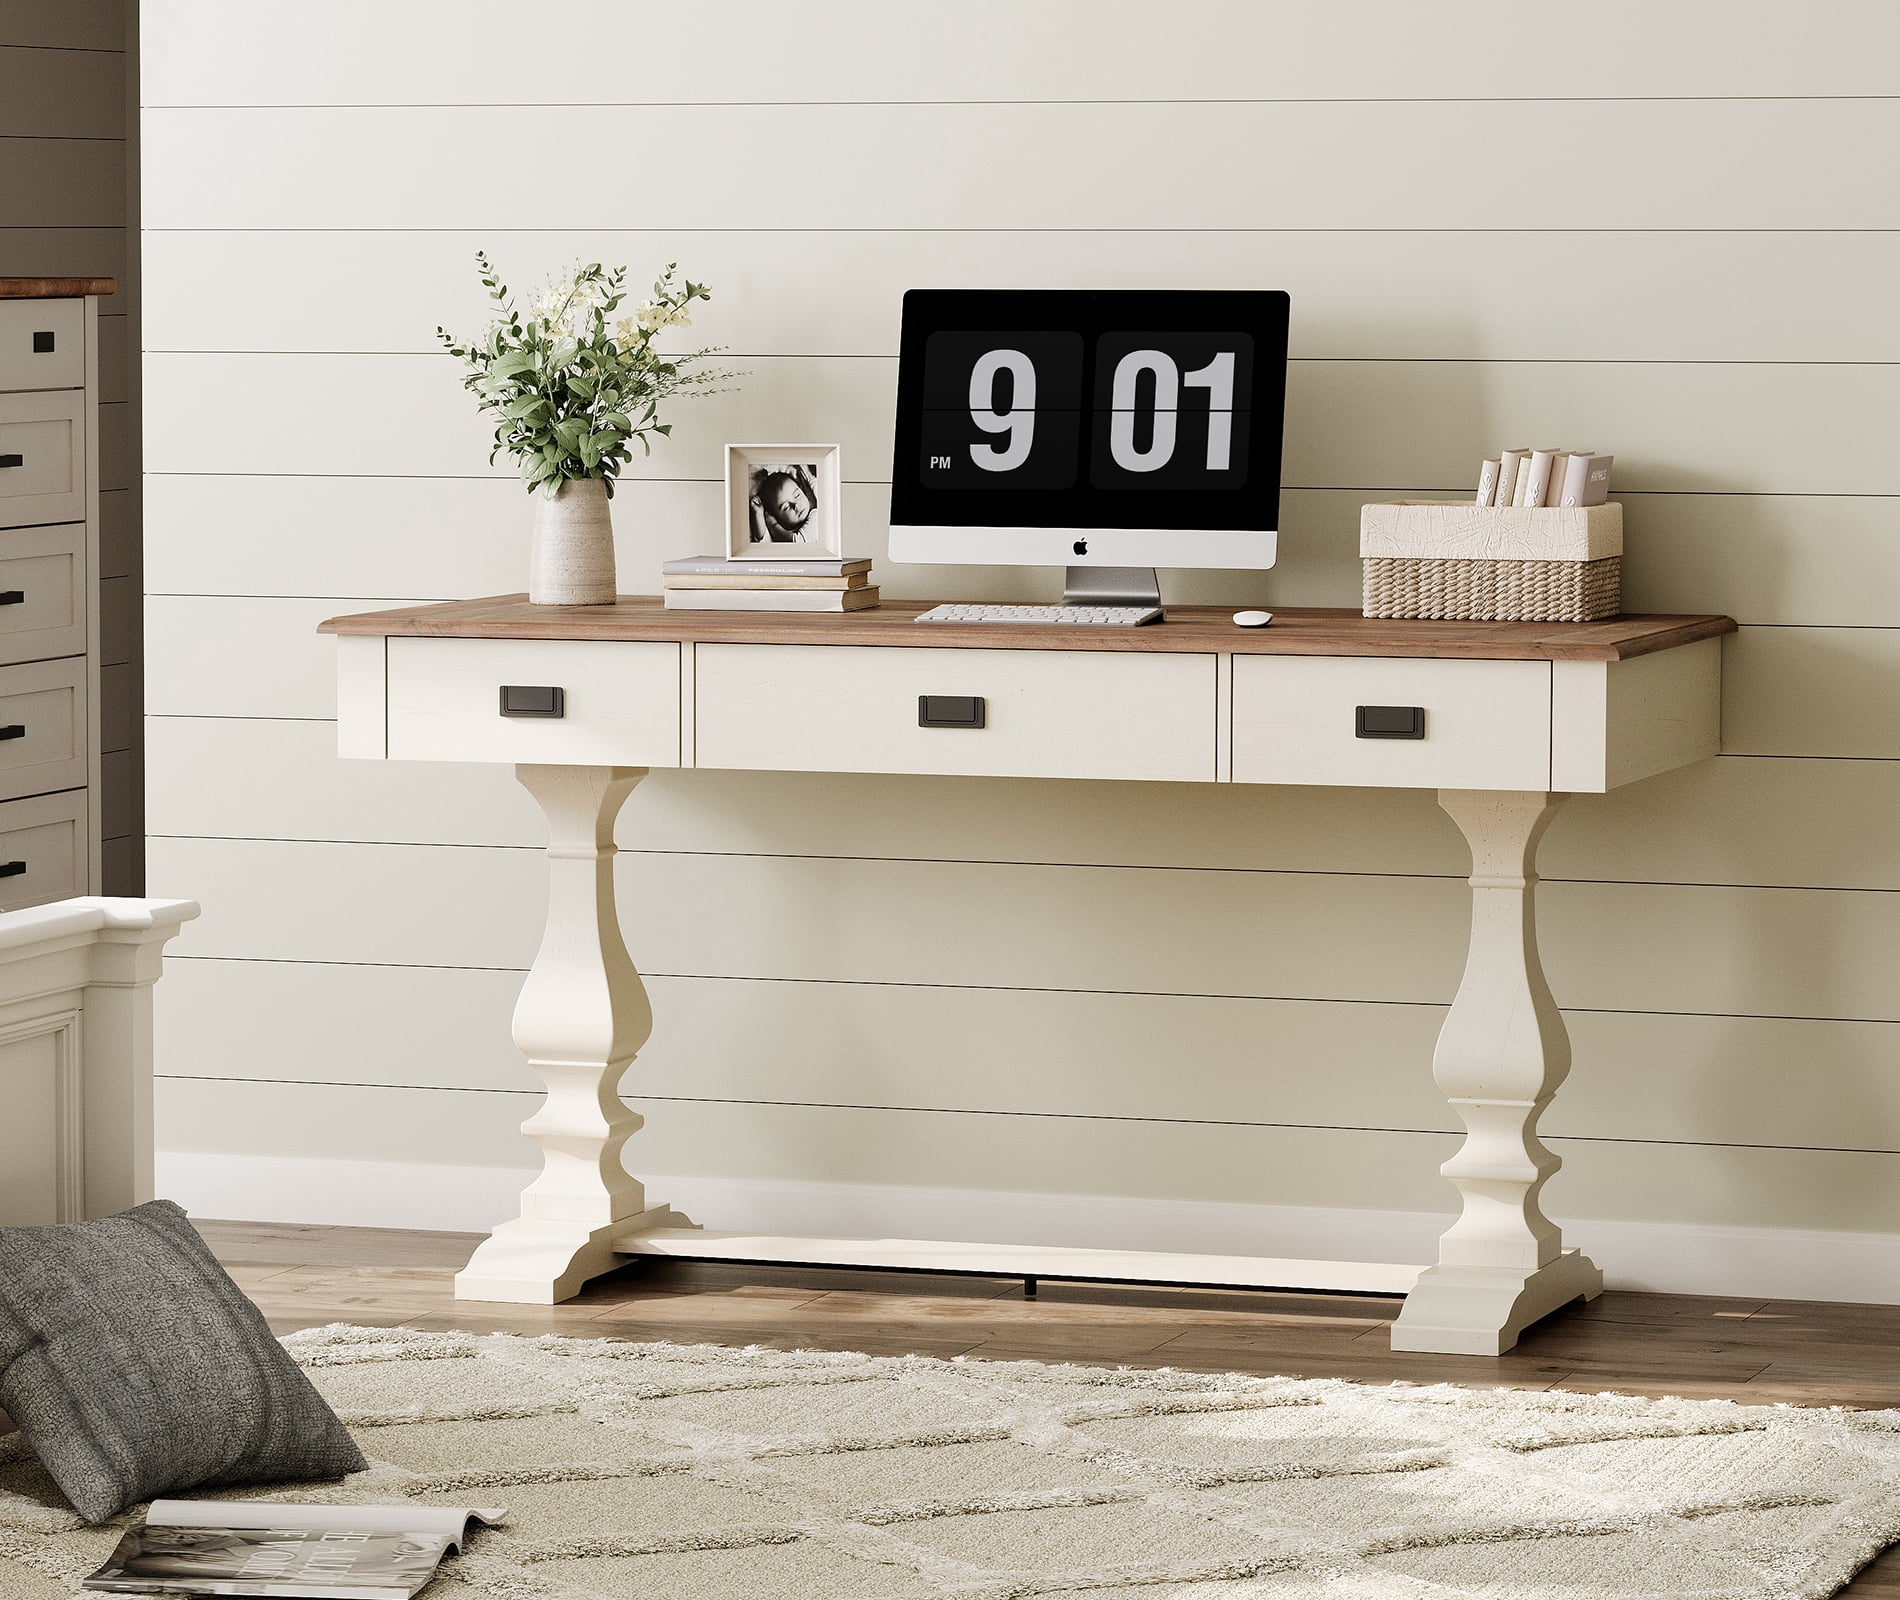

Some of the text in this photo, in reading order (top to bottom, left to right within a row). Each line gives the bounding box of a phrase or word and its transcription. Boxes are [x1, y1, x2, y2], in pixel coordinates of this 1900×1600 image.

[969, 349, 1236, 473] 9 01
[930, 456, 951, 469] PM
